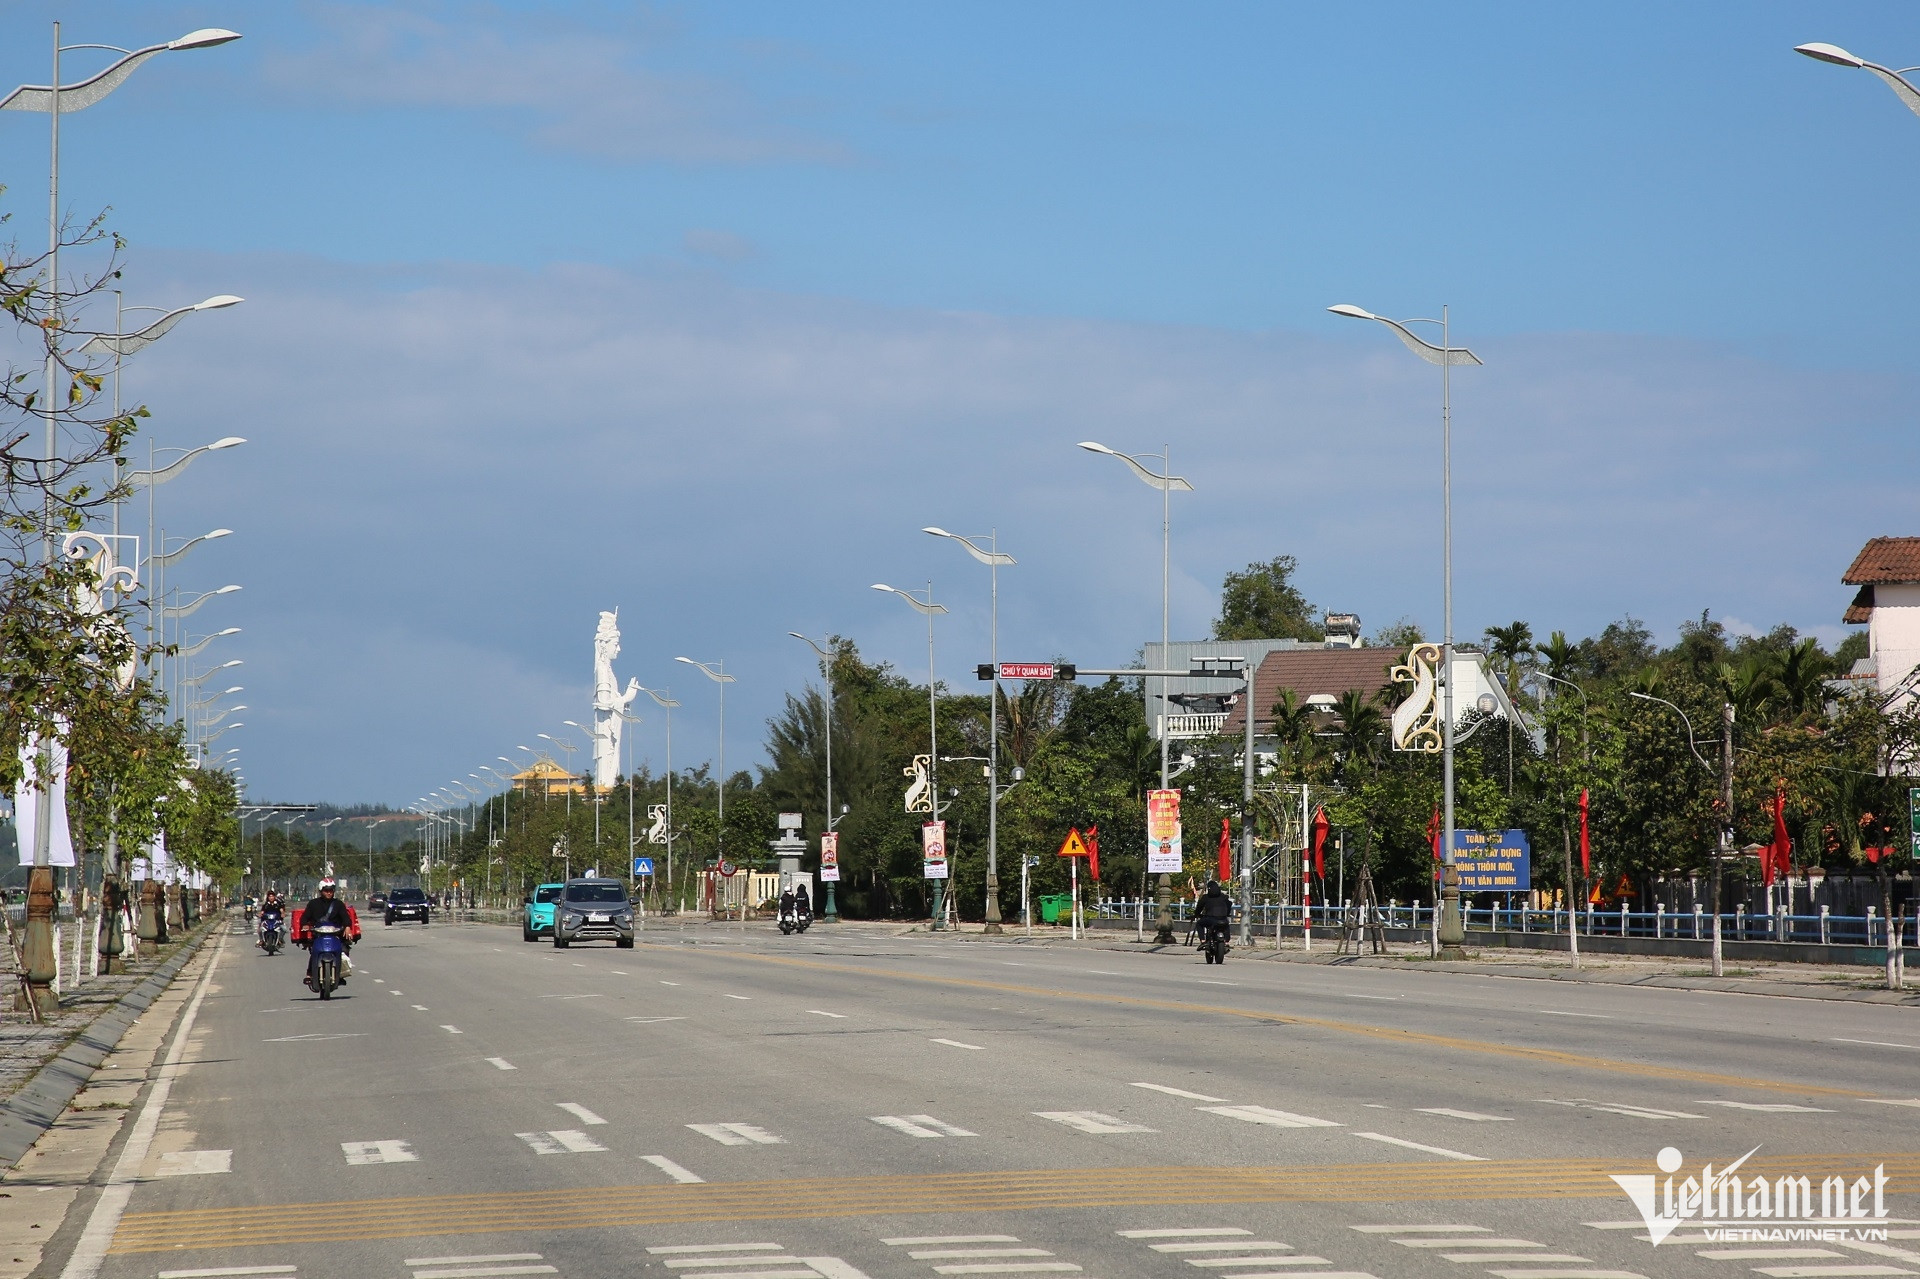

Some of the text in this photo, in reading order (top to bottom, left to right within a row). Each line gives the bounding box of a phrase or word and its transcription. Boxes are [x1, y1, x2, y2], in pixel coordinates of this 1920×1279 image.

[1002, 666, 1052, 676] CHÚ Ý QUAN SÁT
[1466, 834, 1485, 844] TOÀN
[1501, 848, 1522, 859] DỰNG
[1477, 860, 1496, 871] THÔN
[1464, 876, 1475, 887] THỊ
[1477, 875, 1492, 886] VĂN
[1494, 876, 1516, 885] MINH!
